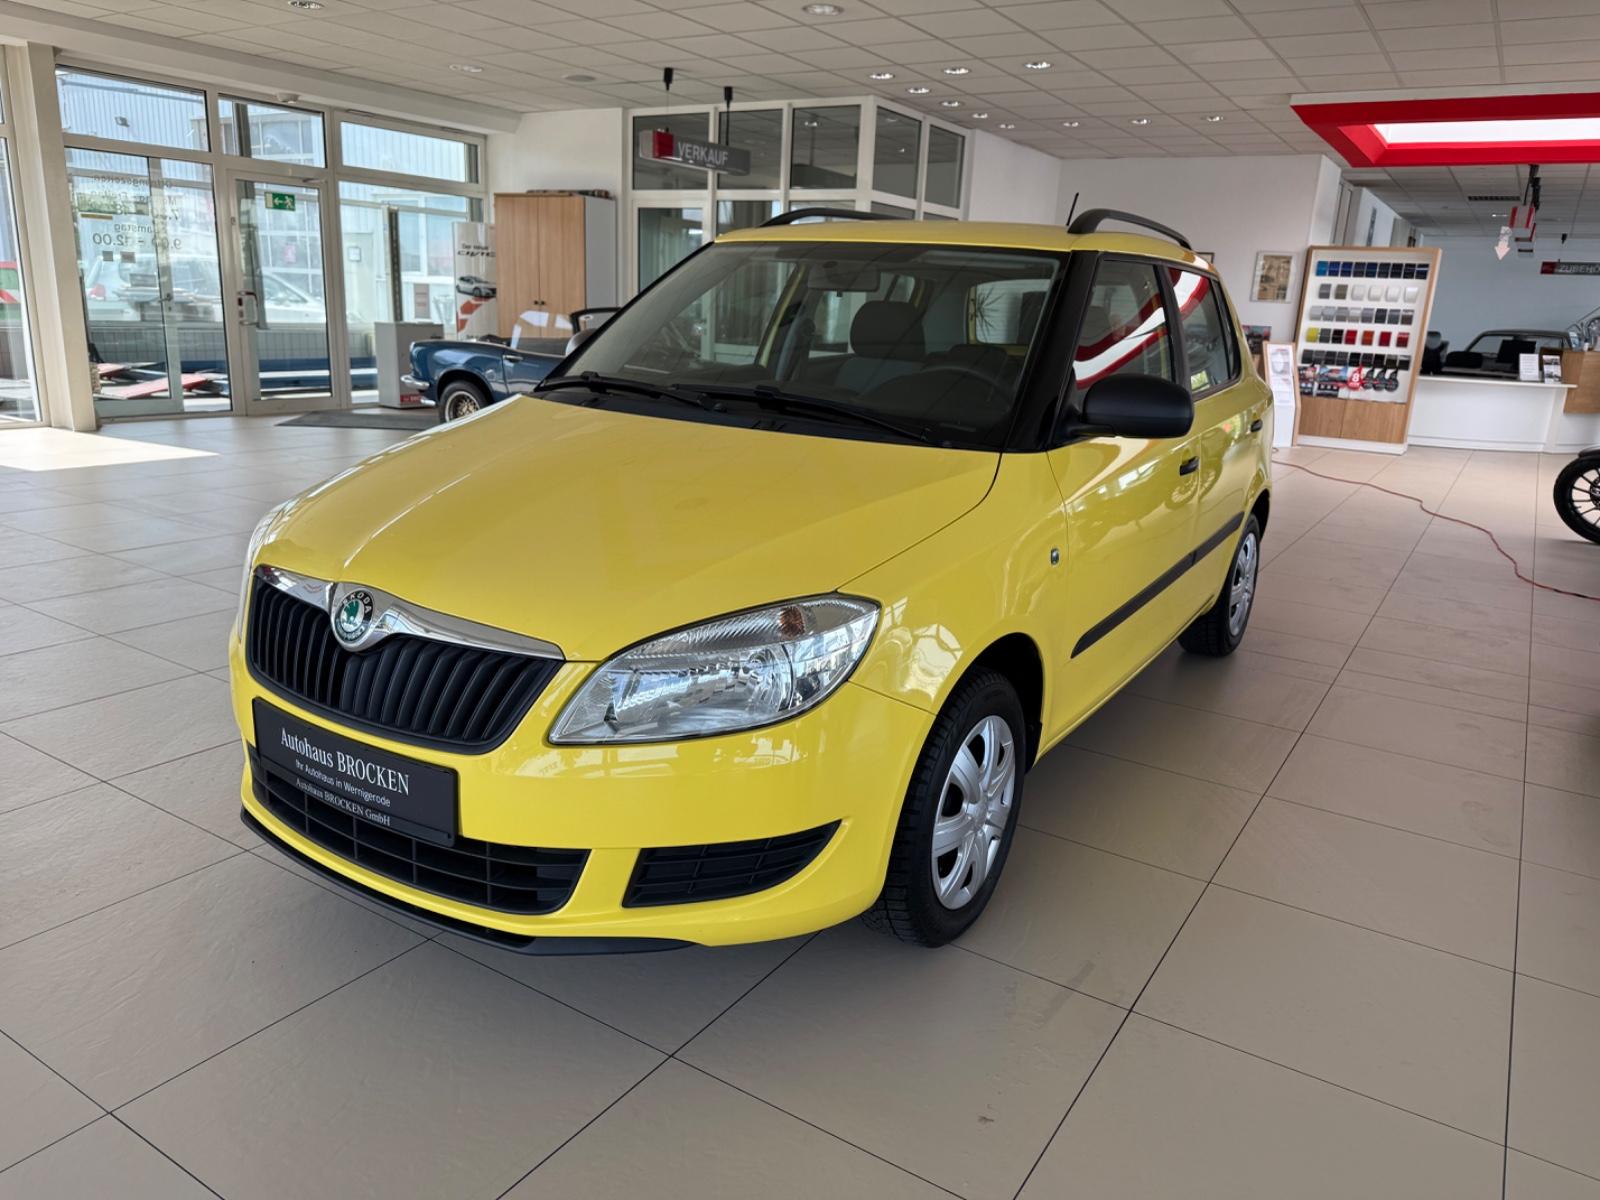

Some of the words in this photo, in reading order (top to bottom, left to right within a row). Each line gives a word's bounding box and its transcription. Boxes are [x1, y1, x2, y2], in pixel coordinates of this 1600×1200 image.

[678, 142, 729, 166] VERKAUF
[281, 728, 334, 768] Autohaus
[337, 751, 410, 796] BROCKEN
[305, 764, 335, 785] Autohaus
[335, 777, 343, 789] in
[343, 781, 391, 808] Wernigerode
[324, 791, 364, 816] BROCKEN
[365, 808, 391, 826] GmbH
